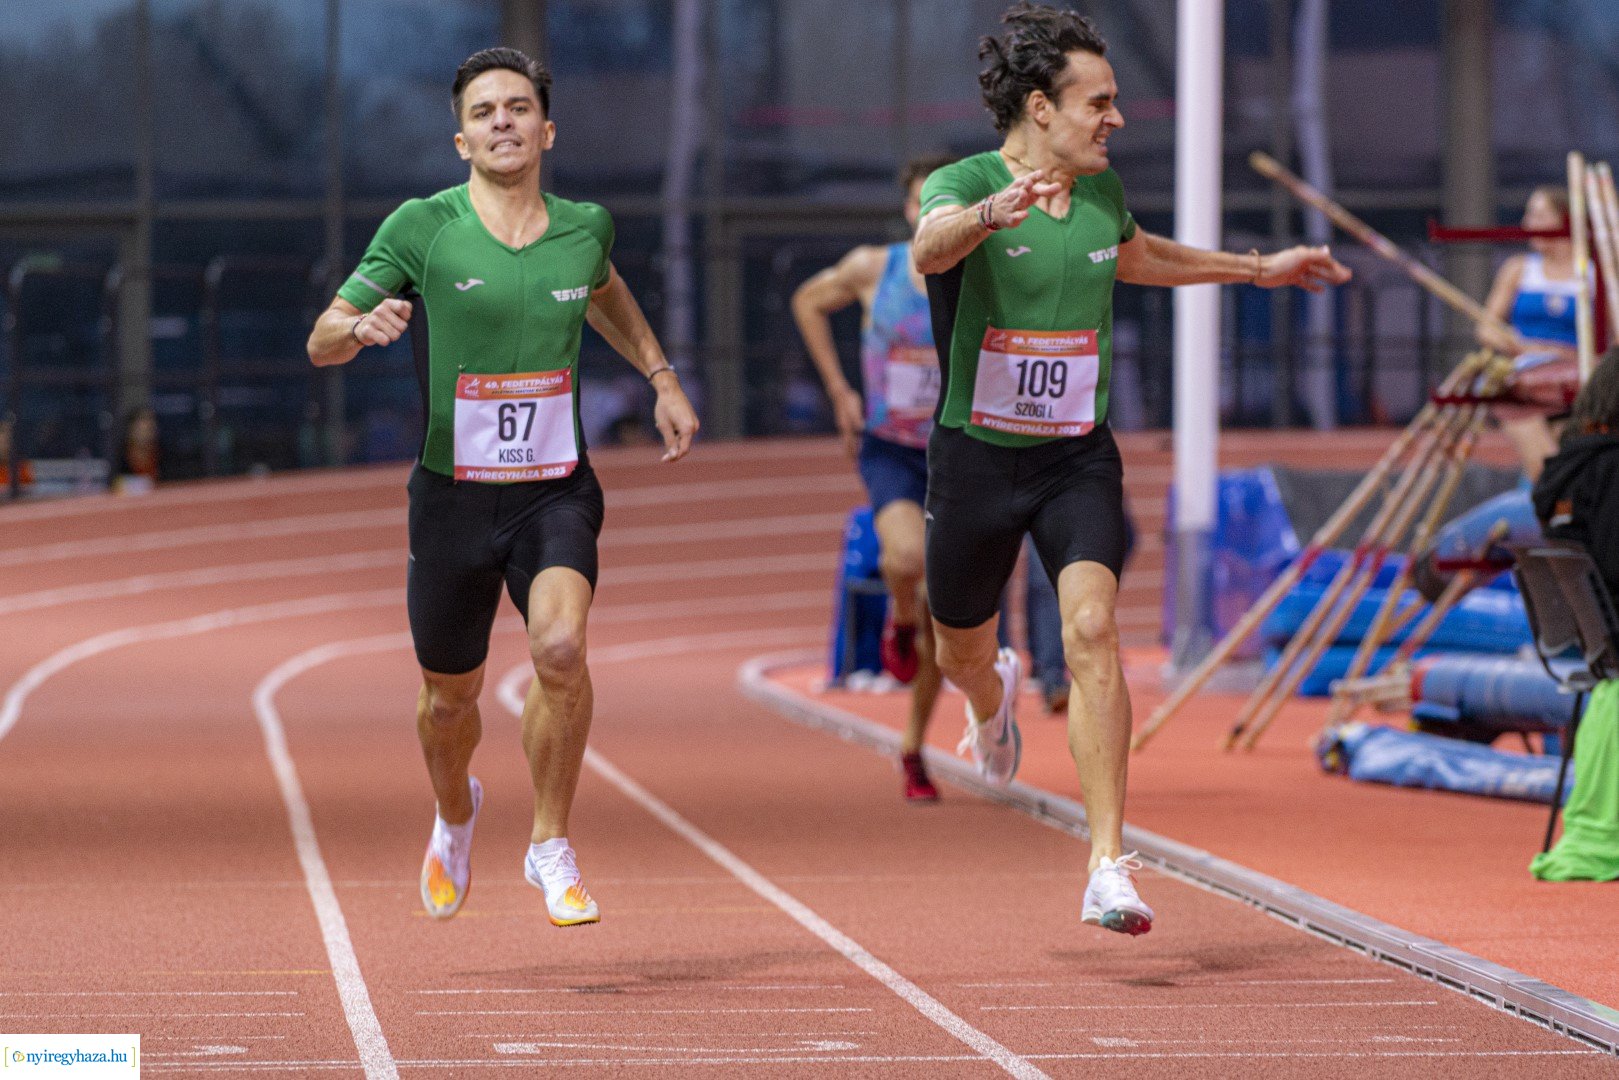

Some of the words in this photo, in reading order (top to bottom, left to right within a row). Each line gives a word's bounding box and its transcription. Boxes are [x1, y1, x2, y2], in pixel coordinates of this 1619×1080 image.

[1016, 360, 1067, 398] 109
[498, 402, 537, 441] 67
[982, 417, 1056, 434] NYÍREGYHÁZA
[498, 448, 523, 463] KISS
[526, 448, 536, 462] G.
[466, 469, 539, 480] NYÍREGYHÁZA
[541, 465, 567, 477] 2023
